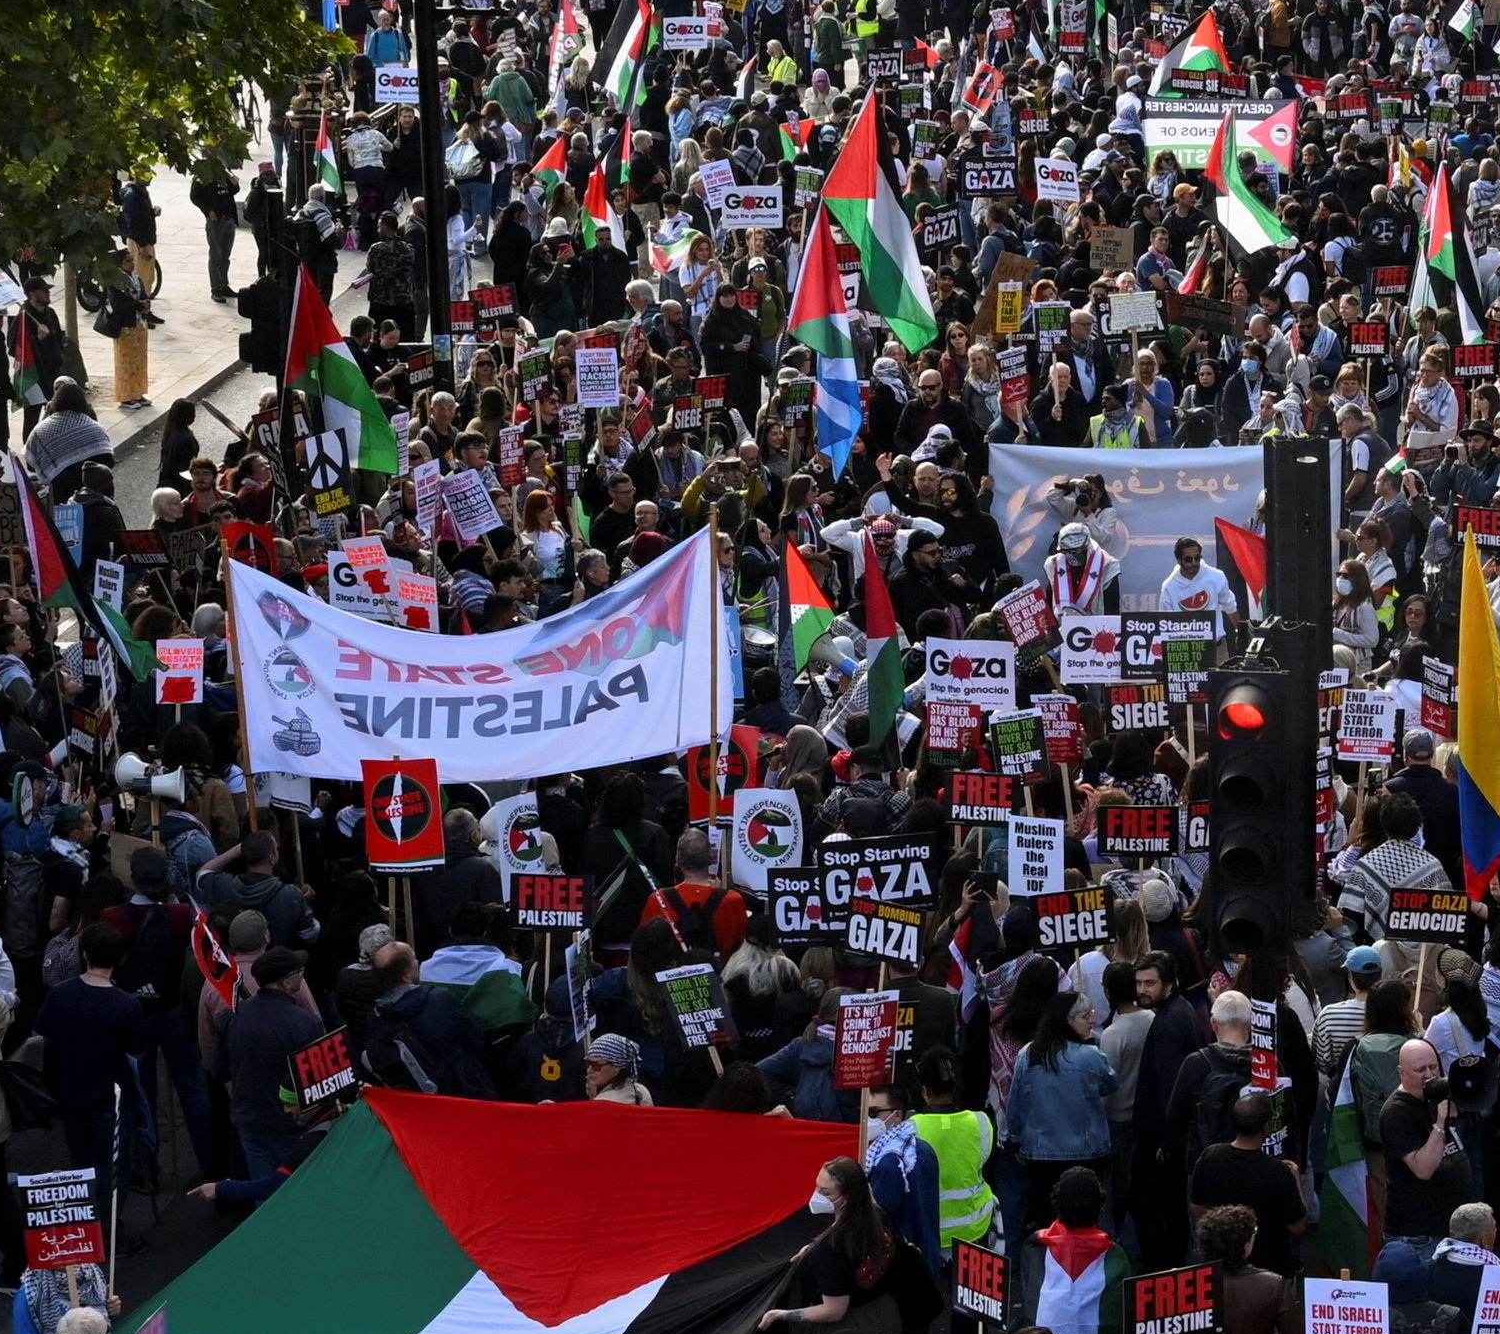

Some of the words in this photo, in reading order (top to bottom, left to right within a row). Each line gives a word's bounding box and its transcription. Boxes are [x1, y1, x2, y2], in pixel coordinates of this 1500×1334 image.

[965, 161, 983, 171] Stop
[984, 161, 1016, 170] Starving
[965, 170, 1016, 190] GAZA
[724, 194, 778, 211] Gza
[1351, 323, 1385, 344] FREE
[1351, 343, 1385, 354] PALESTINE
[1344, 692, 1366, 703] END
[1344, 703, 1384, 715] ISRAELI
[1344, 715, 1374, 727] STATE
[1343, 726, 1383, 738] TERROR
[1135, 1267, 1214, 1322] FREE
[1312, 1304, 1334, 1320] END
[1338, 1305, 1383, 1324] ISRAELI
